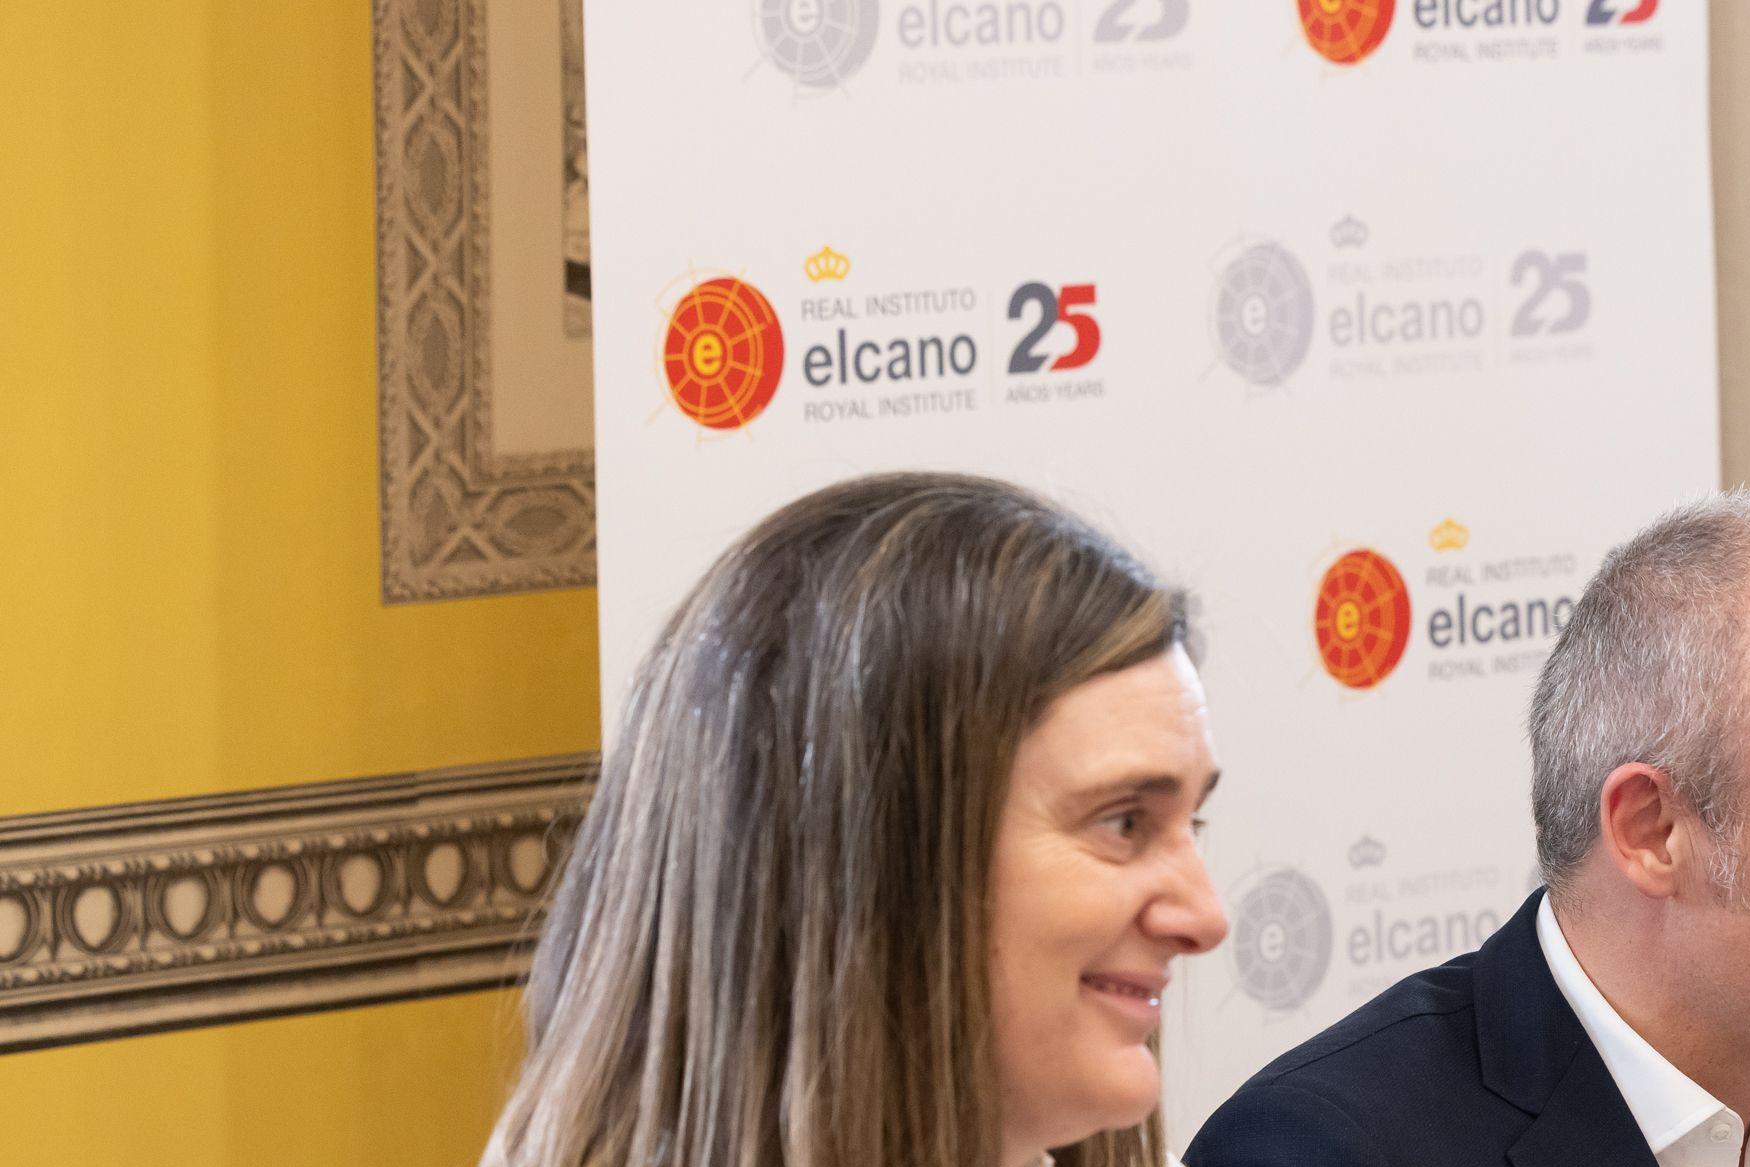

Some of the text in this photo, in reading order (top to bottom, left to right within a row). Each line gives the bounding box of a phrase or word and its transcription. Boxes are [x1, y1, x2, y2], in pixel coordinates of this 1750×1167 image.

[897, 0, 1065, 49] elcano
[897, 55, 1064, 86] ROYAL INSTITUTE
[802, 289, 976, 321] REAL INSTITUTO
[1328, 291, 1484, 347] elcano
[1510, 249, 1591, 338] 25
[1006, 281, 1102, 375] 25
[803, 328, 978, 387] elcano
[804, 389, 977, 423] ROYAL INSTITUTE
